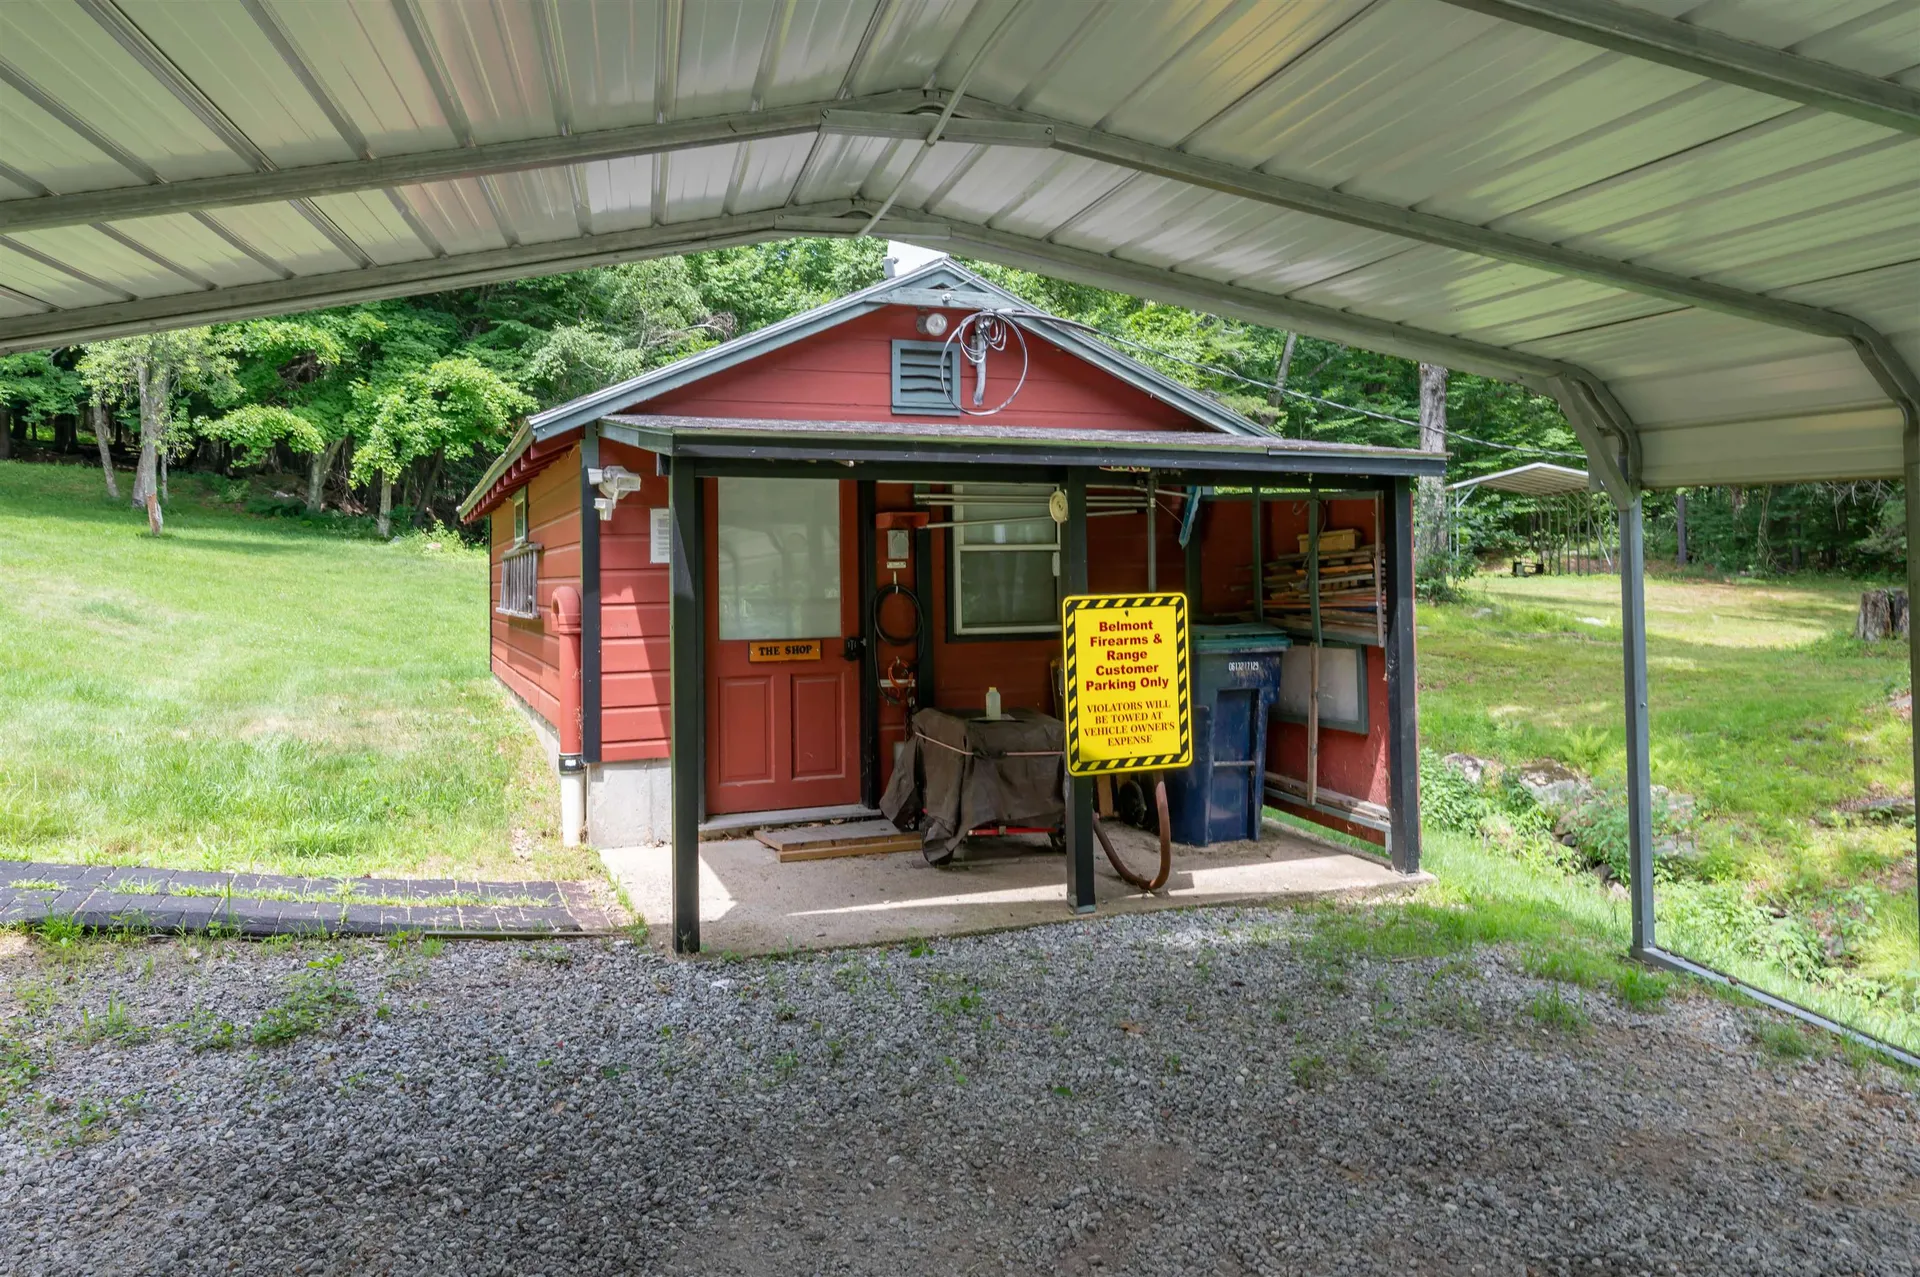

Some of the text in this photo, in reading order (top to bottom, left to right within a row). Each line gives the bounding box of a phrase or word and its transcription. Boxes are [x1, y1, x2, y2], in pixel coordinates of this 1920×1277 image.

[1099, 620, 1153, 632] Belmont
[1090, 634, 1162, 647] Firearms &
[759, 645, 812, 656] THE SHOP
[1107, 651, 1147, 662] Range
[1096, 664, 1158, 676] Customer
[1086, 677, 1168, 691] Parking Only
[1087, 700, 1171, 713] VIOLATORS WILL
[1095, 712, 1163, 724] BE TOWED AT
[1084, 722, 1175, 737] VEHICLE OWNER'S
[1108, 735, 1153, 746] EXPENSE
